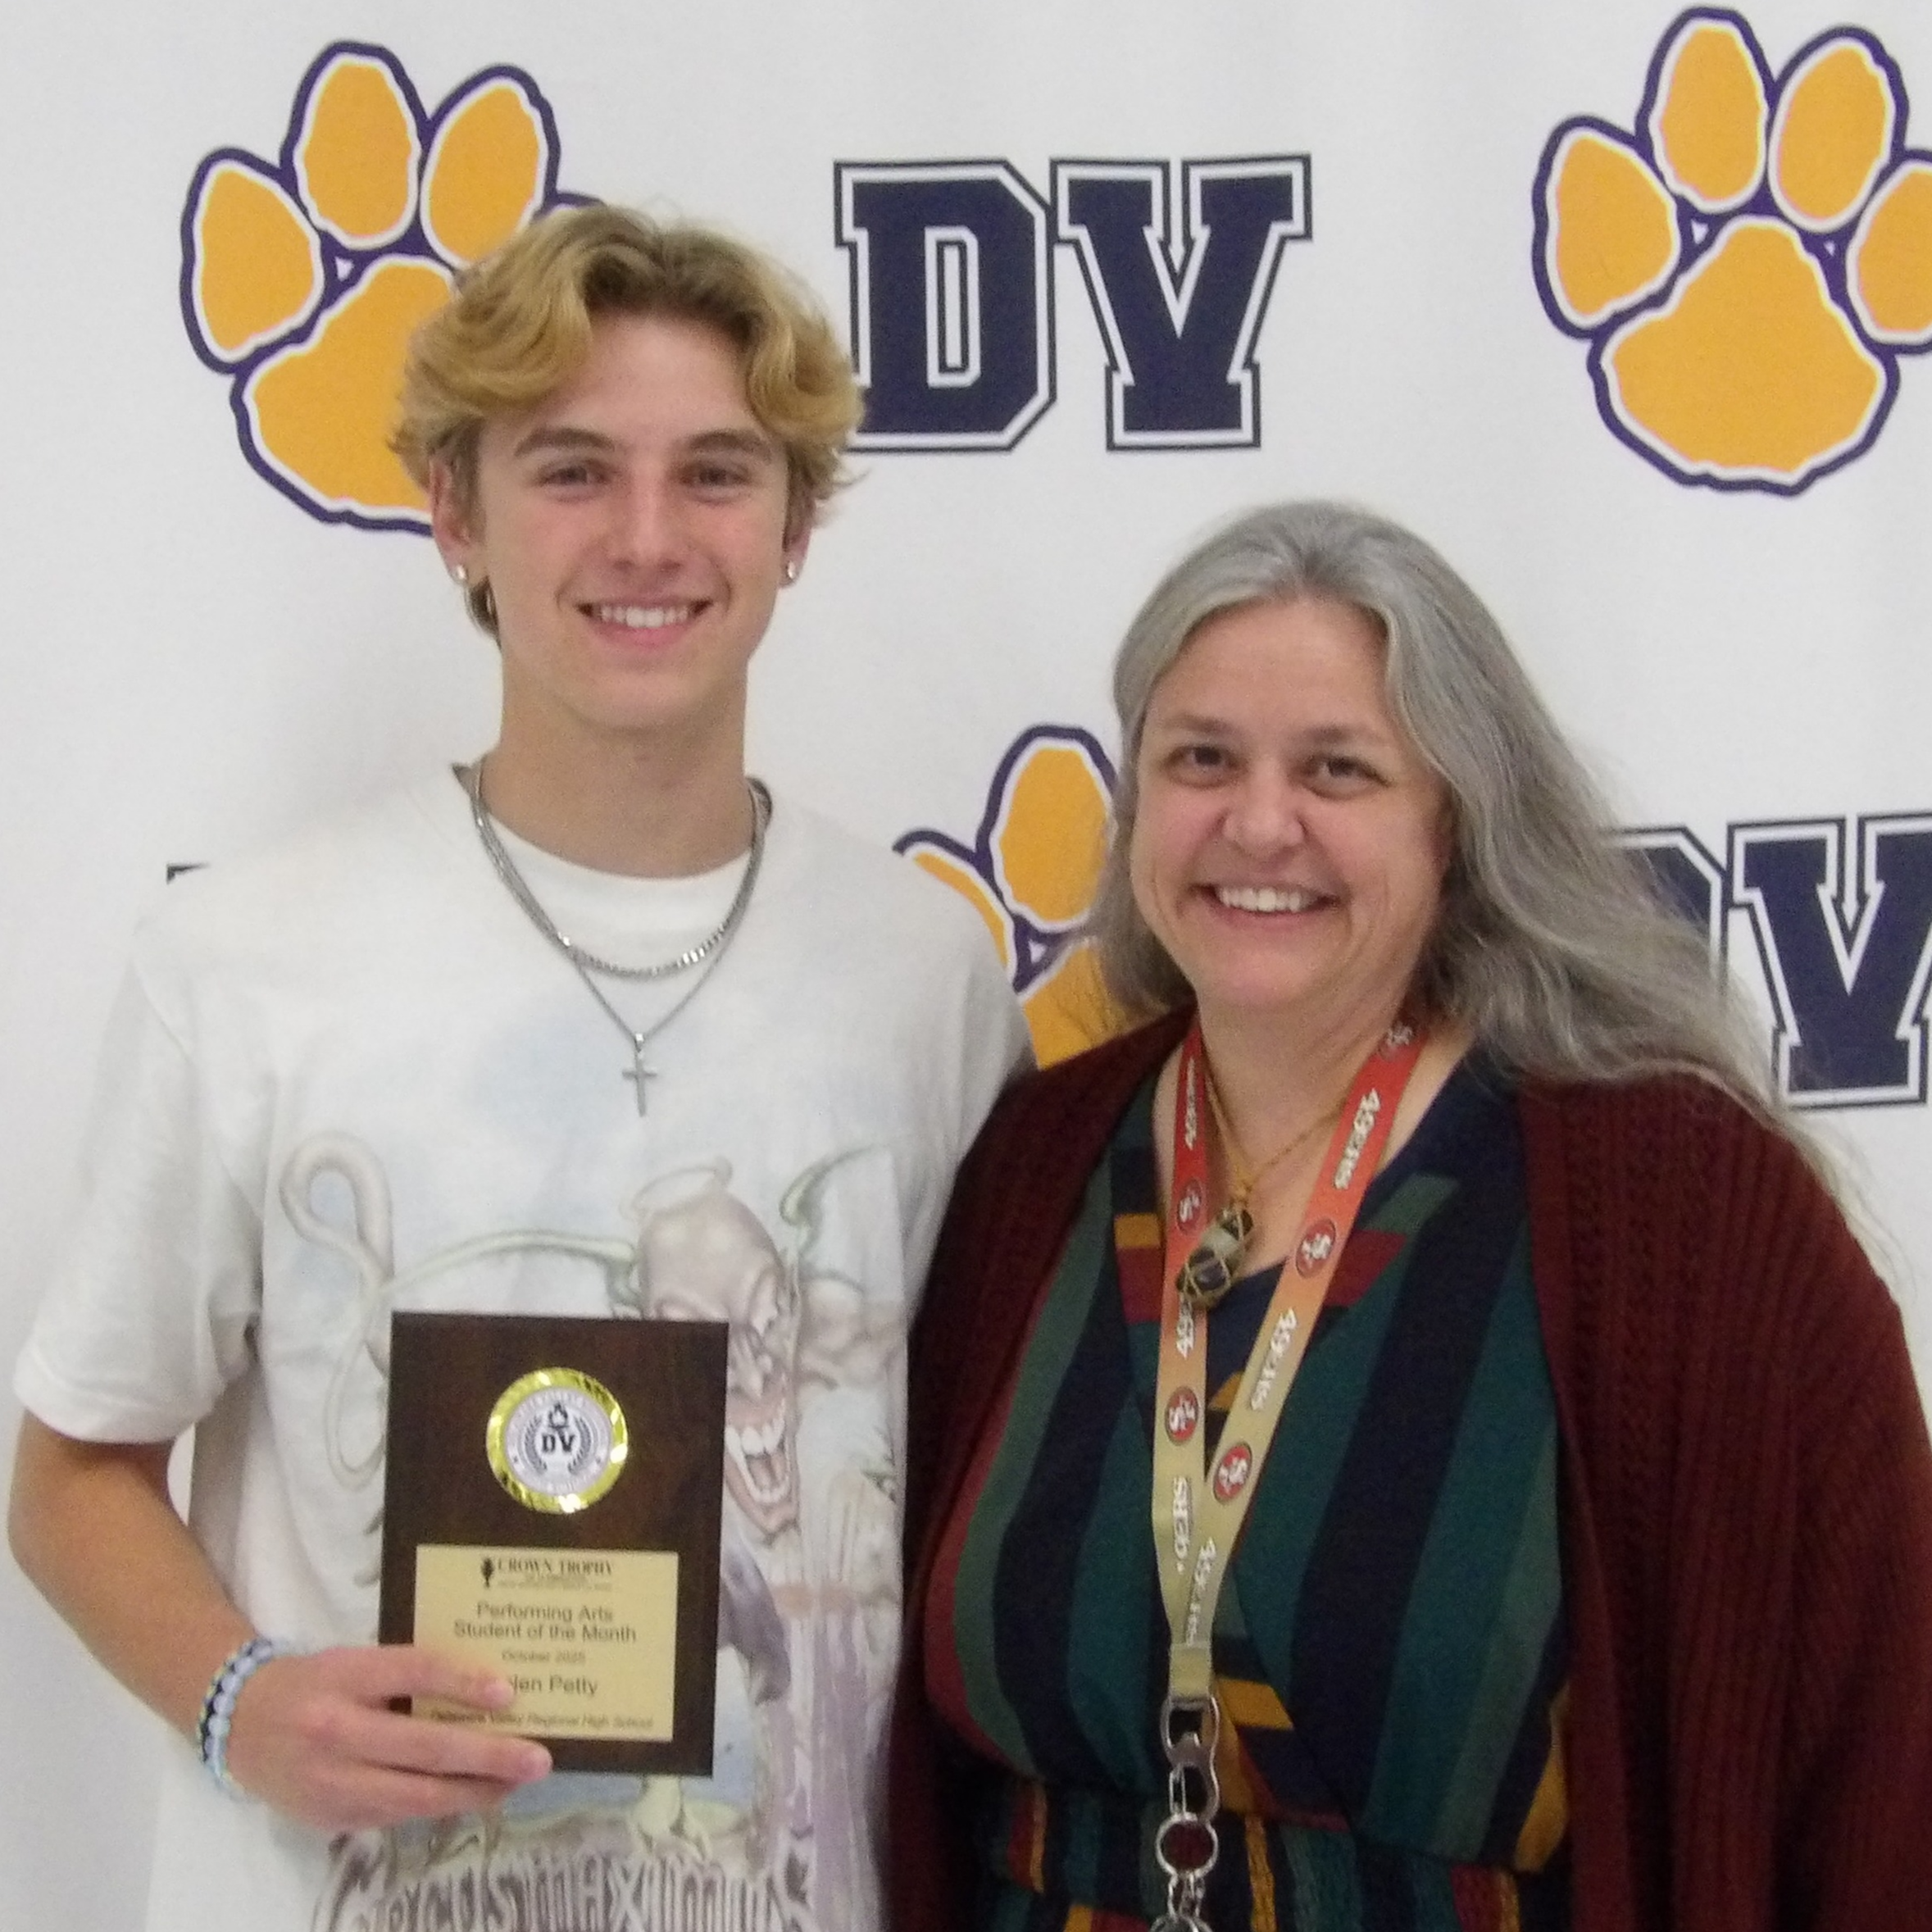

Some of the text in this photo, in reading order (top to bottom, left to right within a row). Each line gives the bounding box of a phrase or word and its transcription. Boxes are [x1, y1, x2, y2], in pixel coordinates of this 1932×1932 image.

[834, 153, 1313, 453] DV
[542, 1434, 575, 1453] DV
[477, 1602, 614, 1623] Performing Arts
[454, 1619, 637, 1643] Student of the Month
[548, 1674, 598, 1698] Petty
